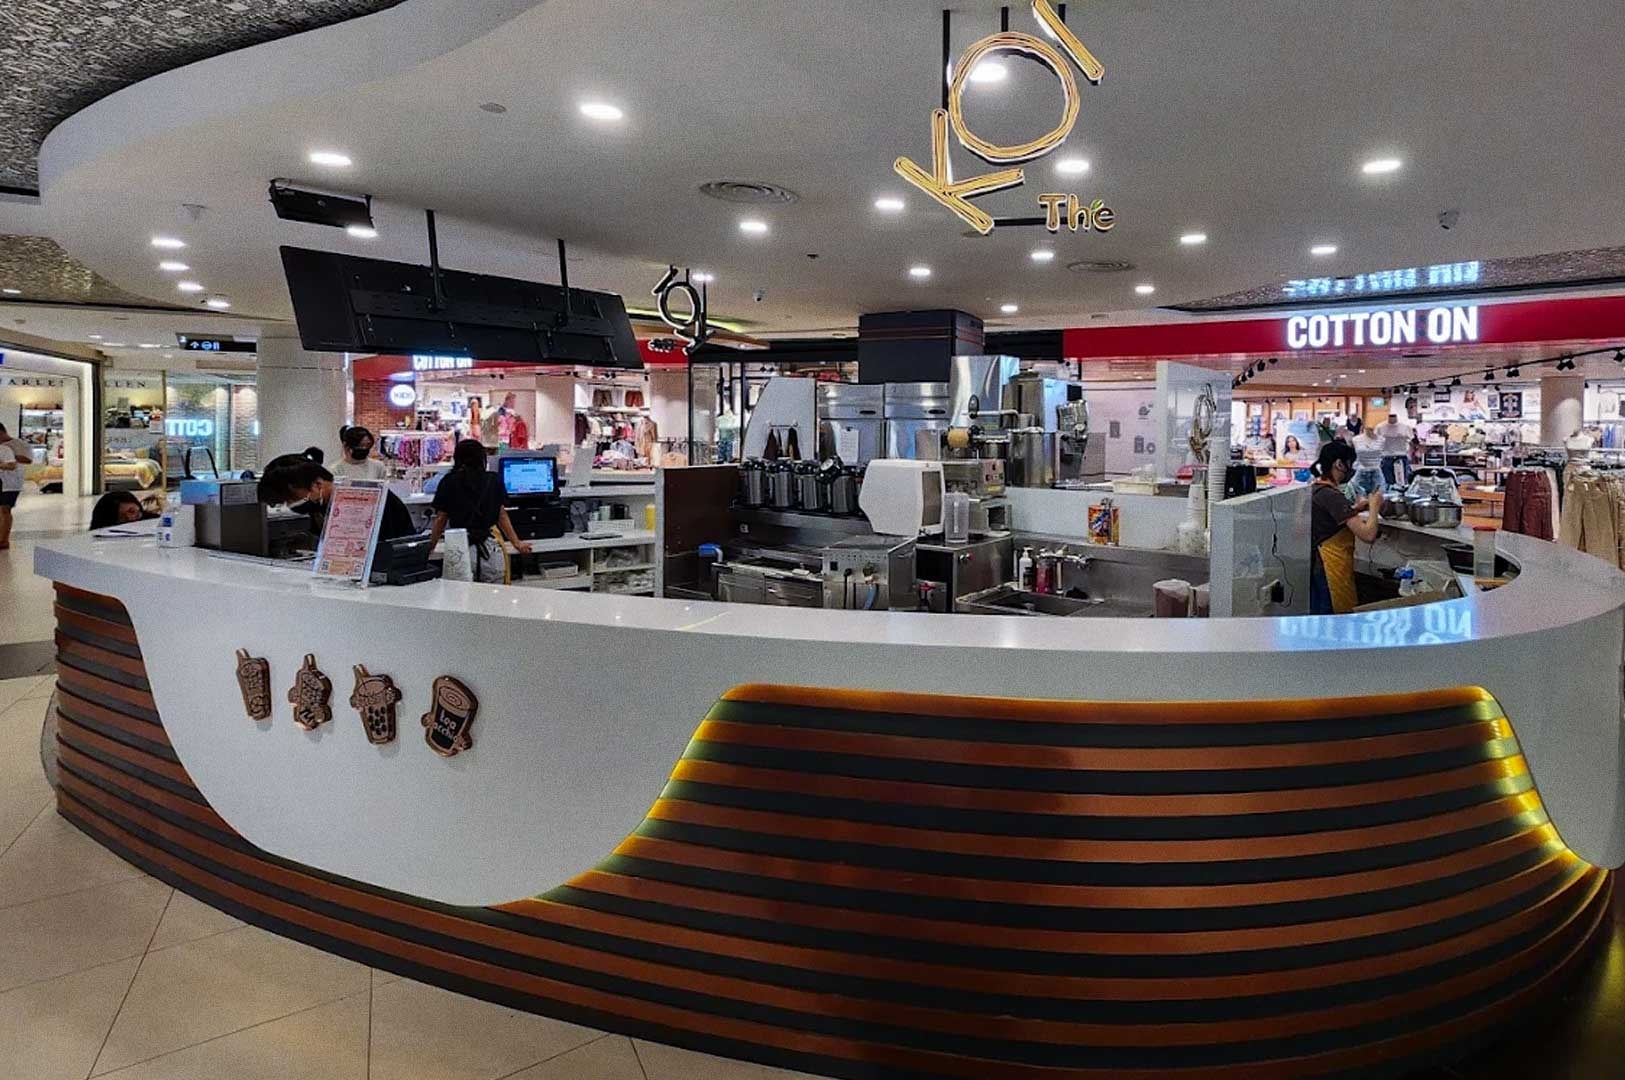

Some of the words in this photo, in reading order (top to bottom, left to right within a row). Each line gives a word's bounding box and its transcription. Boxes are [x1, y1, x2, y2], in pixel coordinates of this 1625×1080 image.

[1287, 311, 1417, 349] COTTON
[1426, 306, 1479, 344] ON
[0, 377, 64, 388] ARLE
